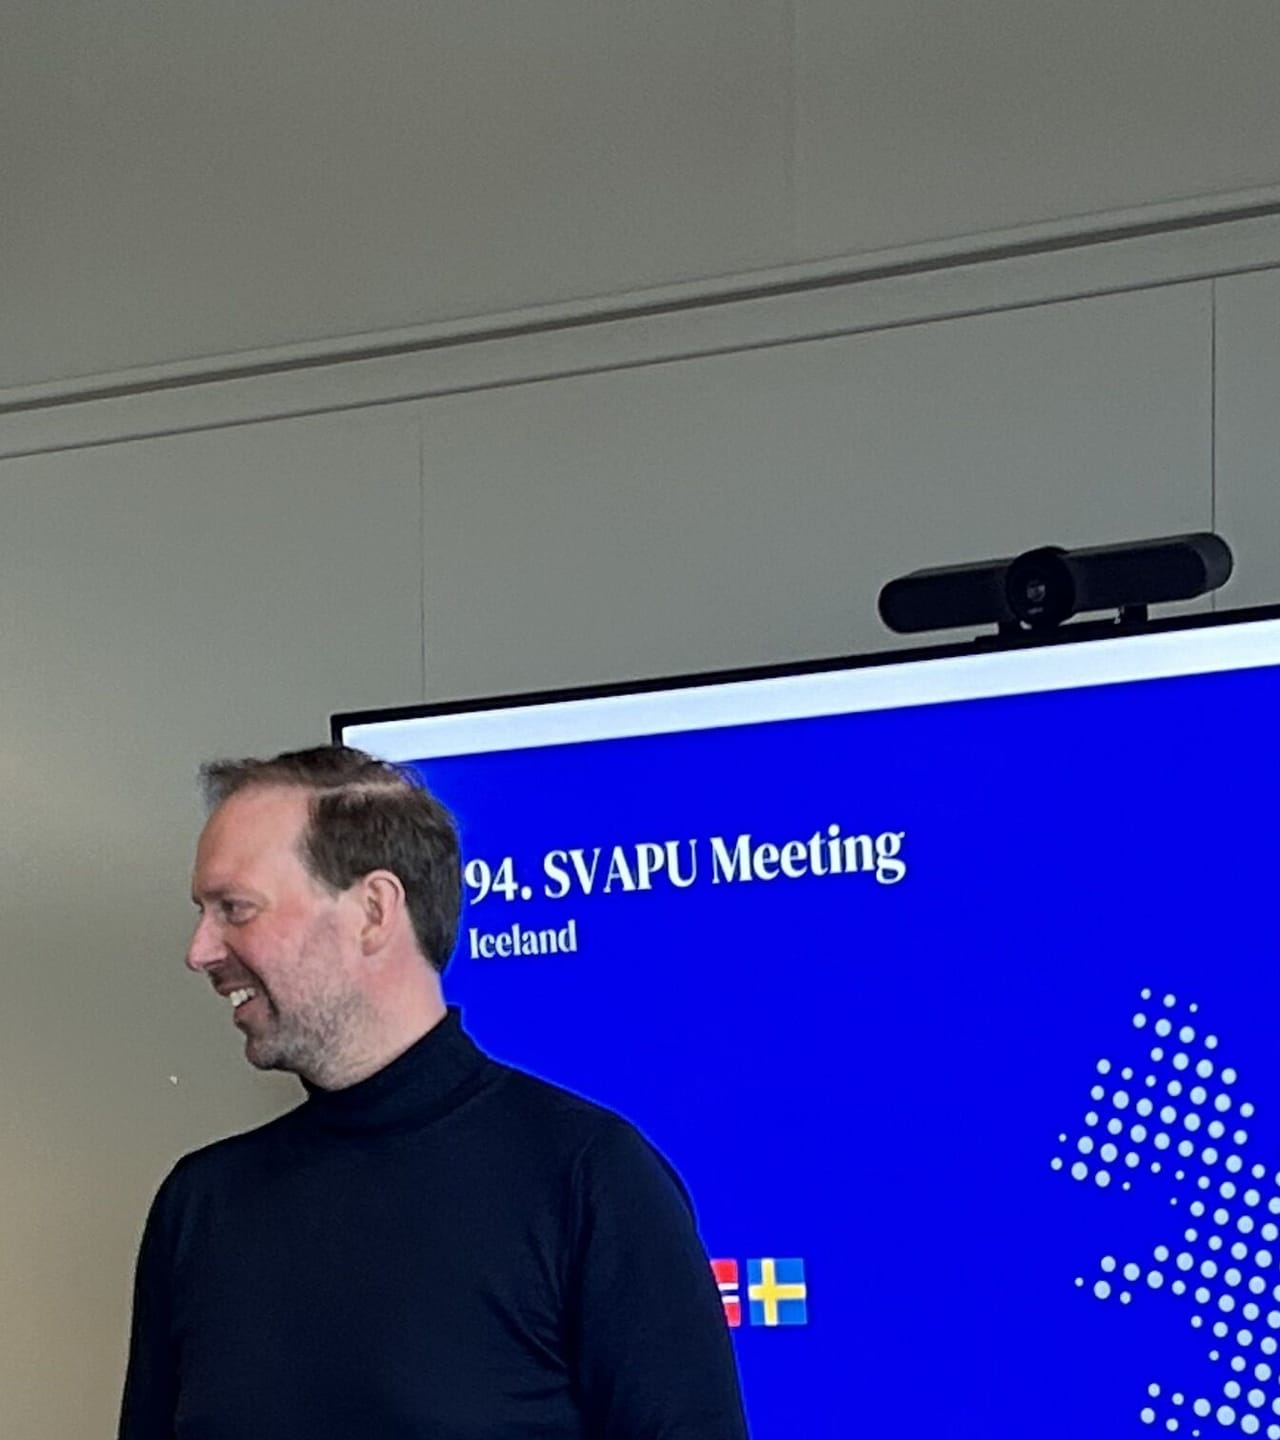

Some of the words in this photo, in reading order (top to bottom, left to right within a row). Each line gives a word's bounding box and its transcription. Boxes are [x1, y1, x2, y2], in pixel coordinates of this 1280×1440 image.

[463, 857, 533, 905] 94.
[543, 840, 697, 899] SVAPU
[710, 823, 907, 885] Meeting
[468, 919, 578, 960] Iceland
